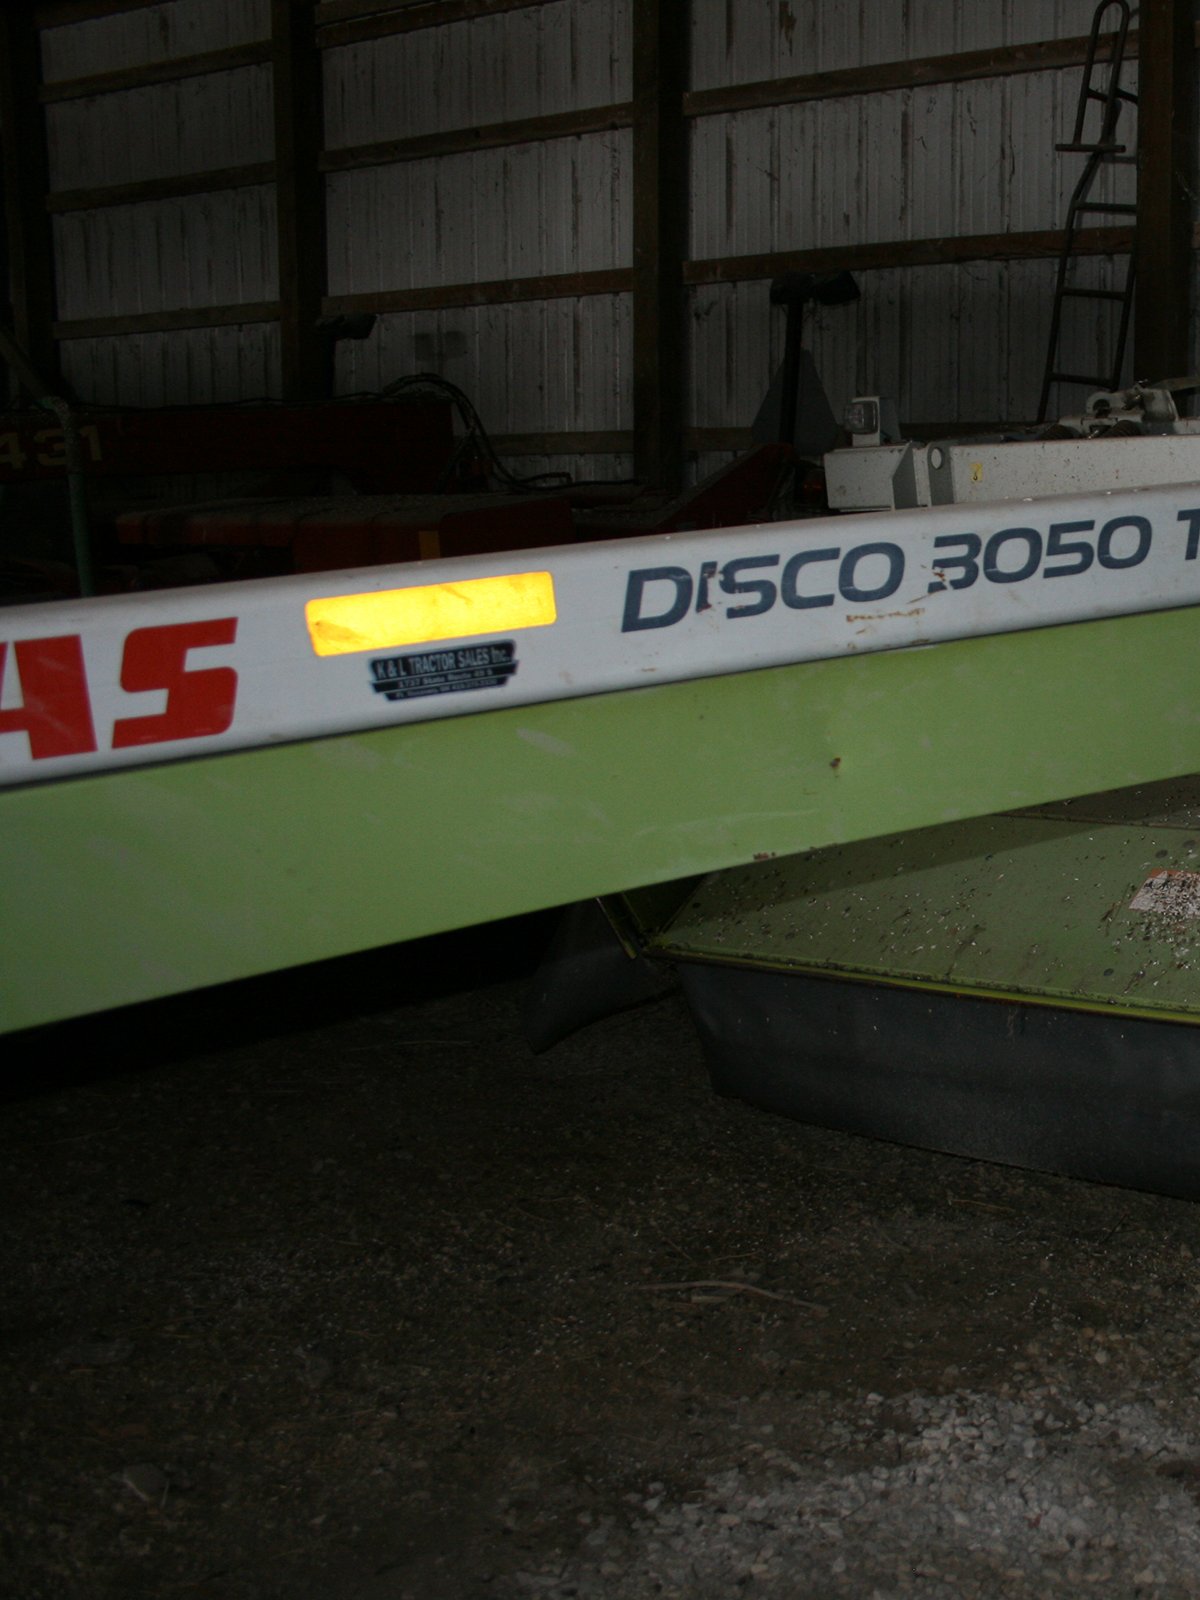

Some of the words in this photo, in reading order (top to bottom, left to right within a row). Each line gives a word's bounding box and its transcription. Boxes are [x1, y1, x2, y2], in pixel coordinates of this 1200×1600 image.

[621, 541, 906, 633] DISCO
[928, 514, 1154, 592] 3050
[408, 652, 456, 674] TRACTOR
[457, 648, 490, 668] SALES
